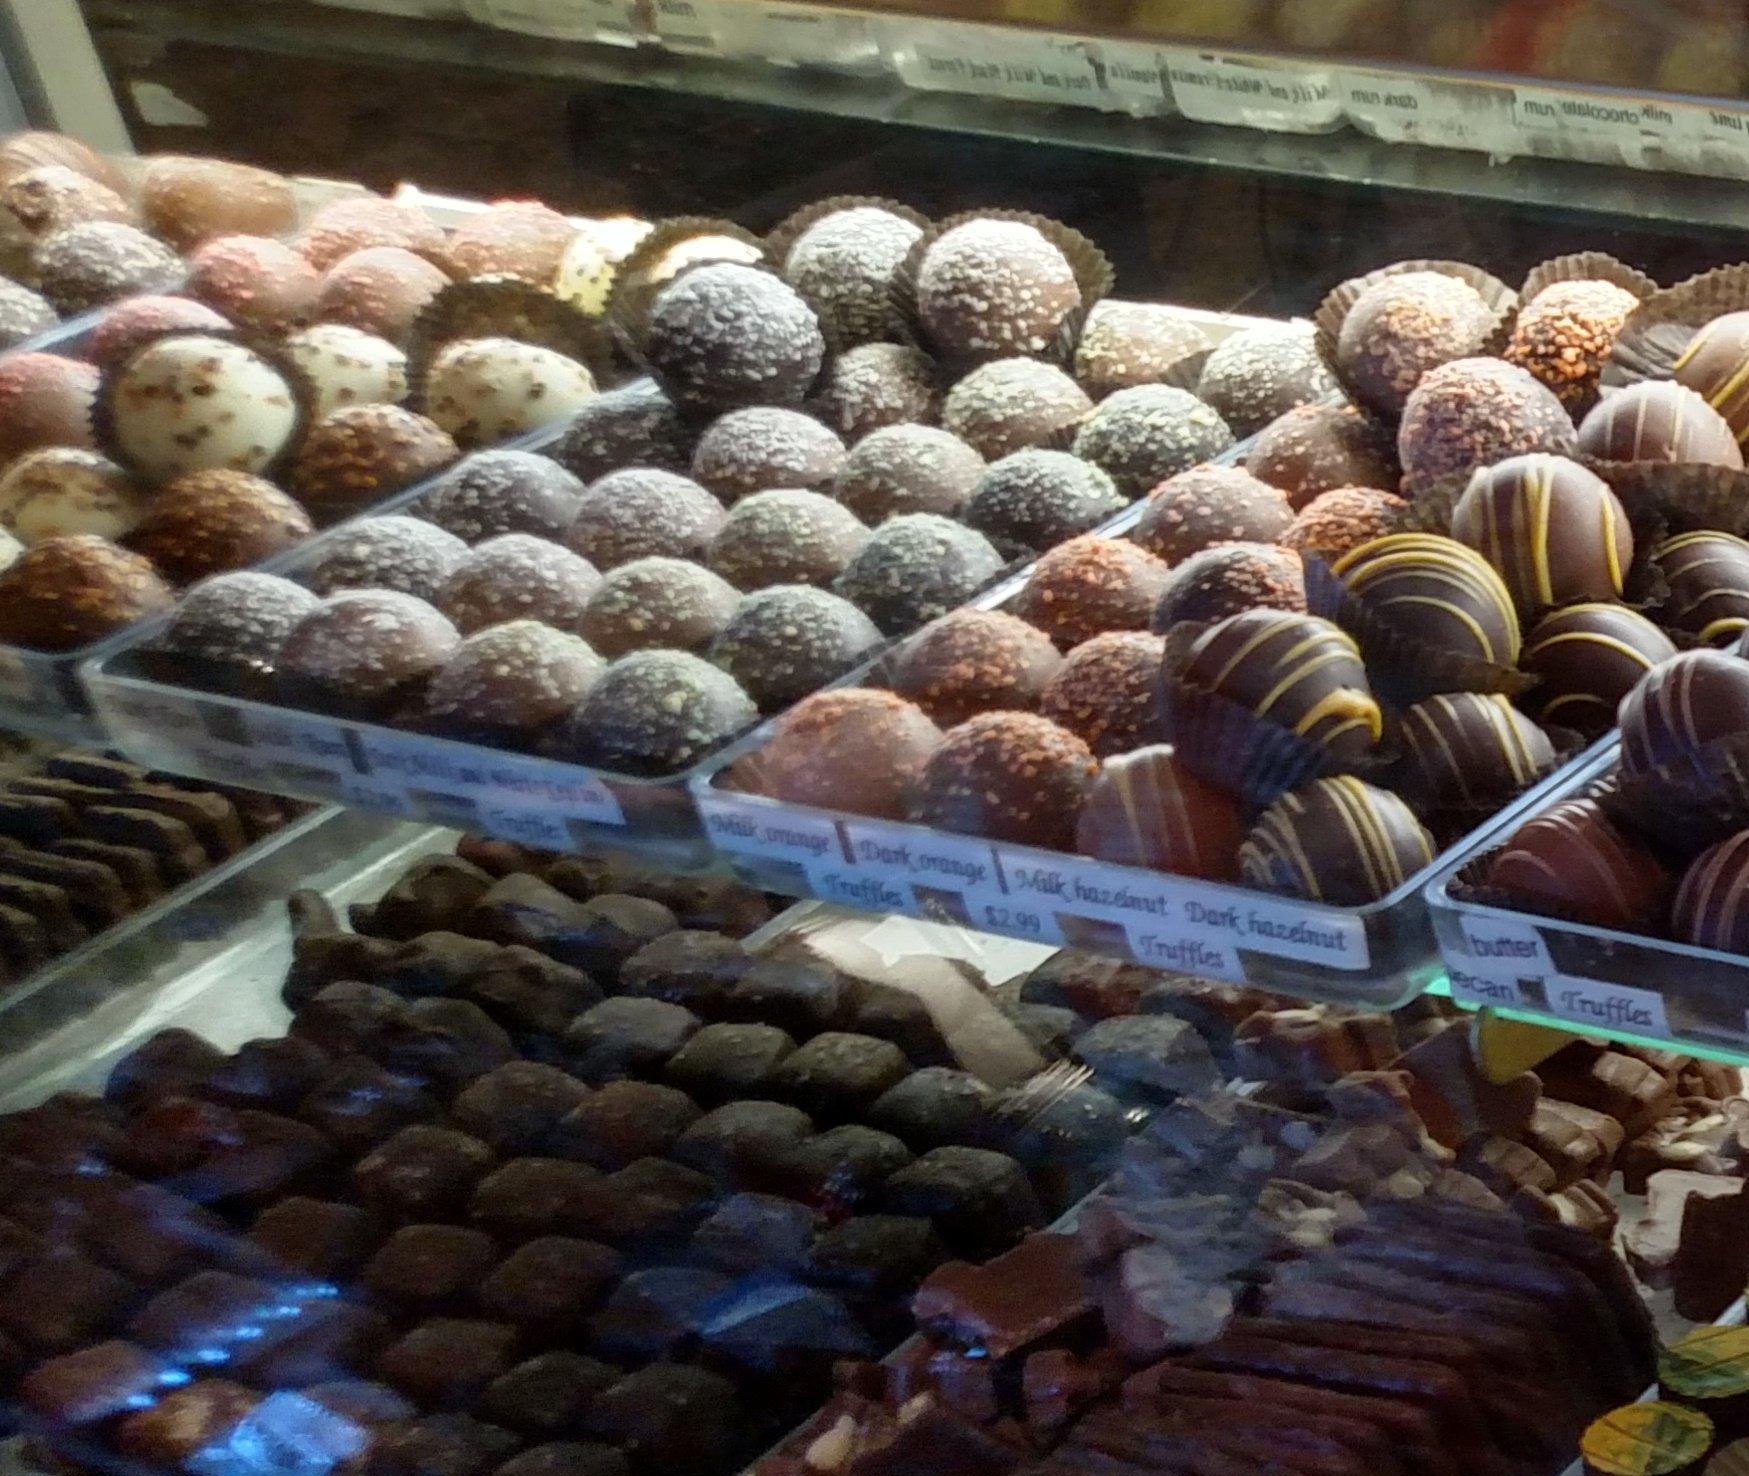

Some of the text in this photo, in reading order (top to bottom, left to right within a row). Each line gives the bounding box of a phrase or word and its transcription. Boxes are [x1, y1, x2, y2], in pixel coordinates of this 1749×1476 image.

[712, 813, 830, 857] Milk orange
[859, 839, 987, 886] Dark orange
[820, 871, 904, 908] Truffles
[984, 905, 1041, 934] $2.99
[1016, 868, 1348, 952] Milk hazelnut Dark hazelnut
[1141, 934, 1224, 970] Truffles
[1470, 934, 1539, 959] butter
[1561, 989, 1653, 1028] Truffles
